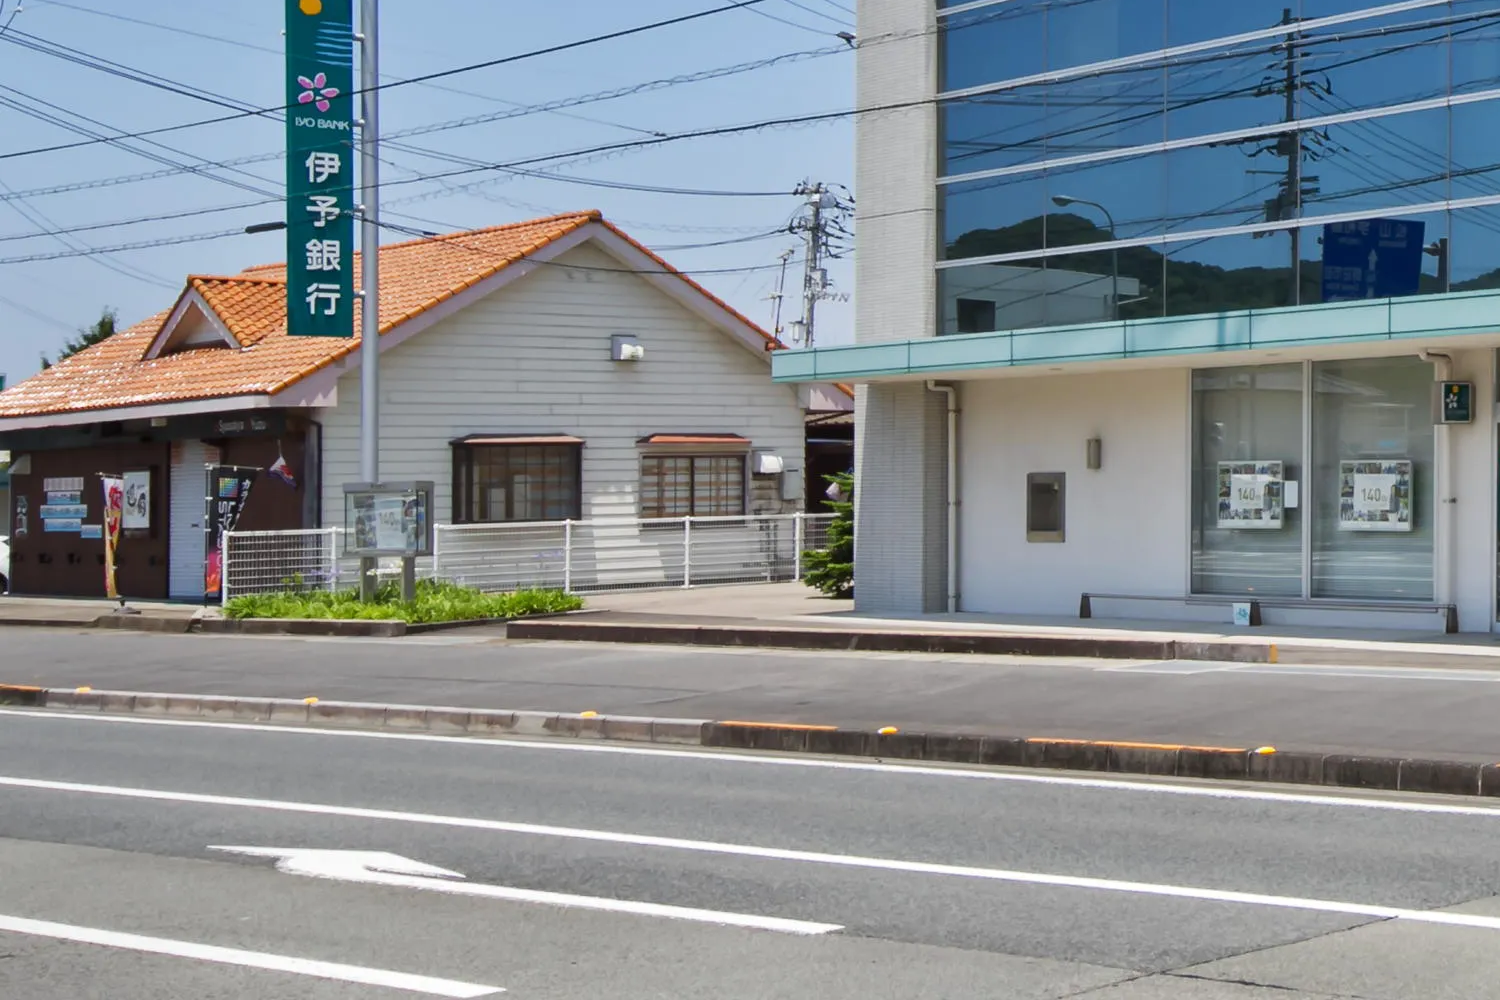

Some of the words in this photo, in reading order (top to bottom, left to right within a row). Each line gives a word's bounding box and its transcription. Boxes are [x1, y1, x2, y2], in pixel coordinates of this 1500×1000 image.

[295, 116, 315, 128] IYO
[317, 118, 350, 131] BANK
[305, 151, 341, 315] 伊予銀行
[1361, 487, 1381, 502] 140
